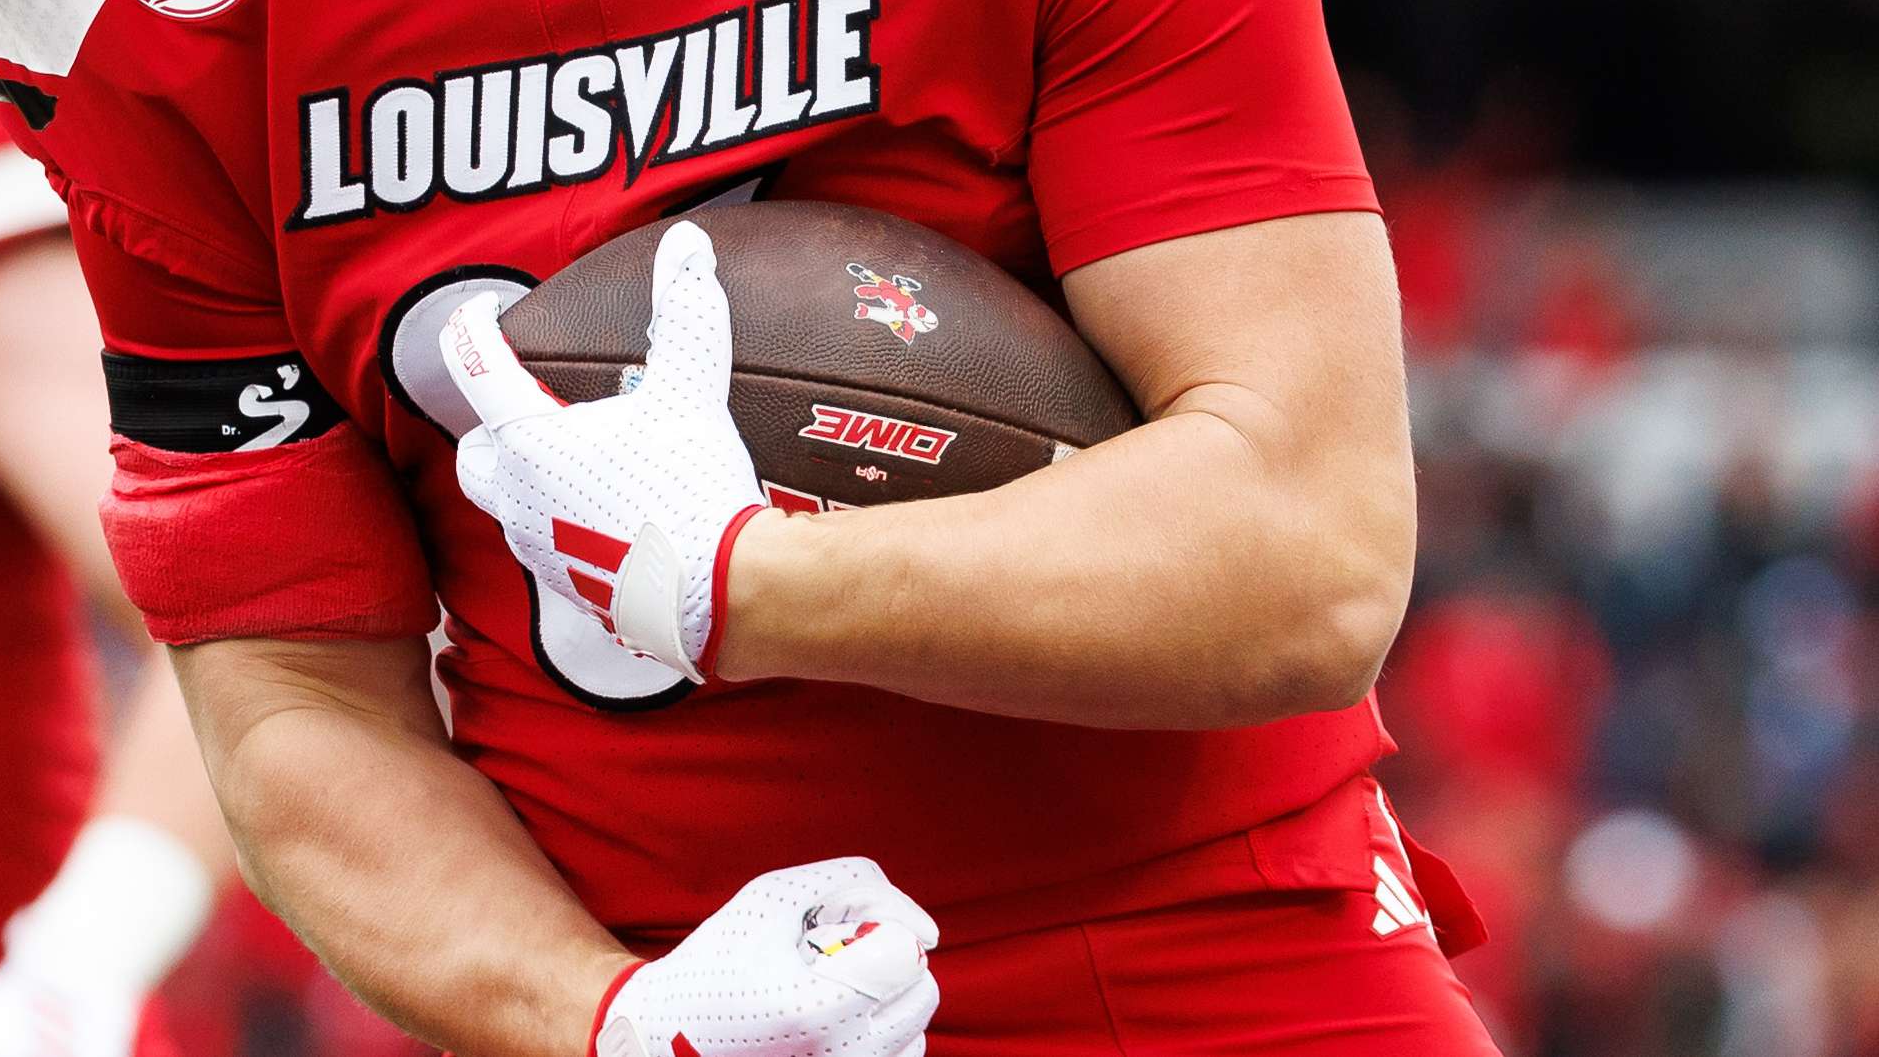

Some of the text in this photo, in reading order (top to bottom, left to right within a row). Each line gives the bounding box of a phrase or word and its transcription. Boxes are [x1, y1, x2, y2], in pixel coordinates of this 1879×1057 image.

[222, 426, 241, 436] Dr.
[798, 404, 958, 465] DIME
[856, 465, 887, 481] USA
